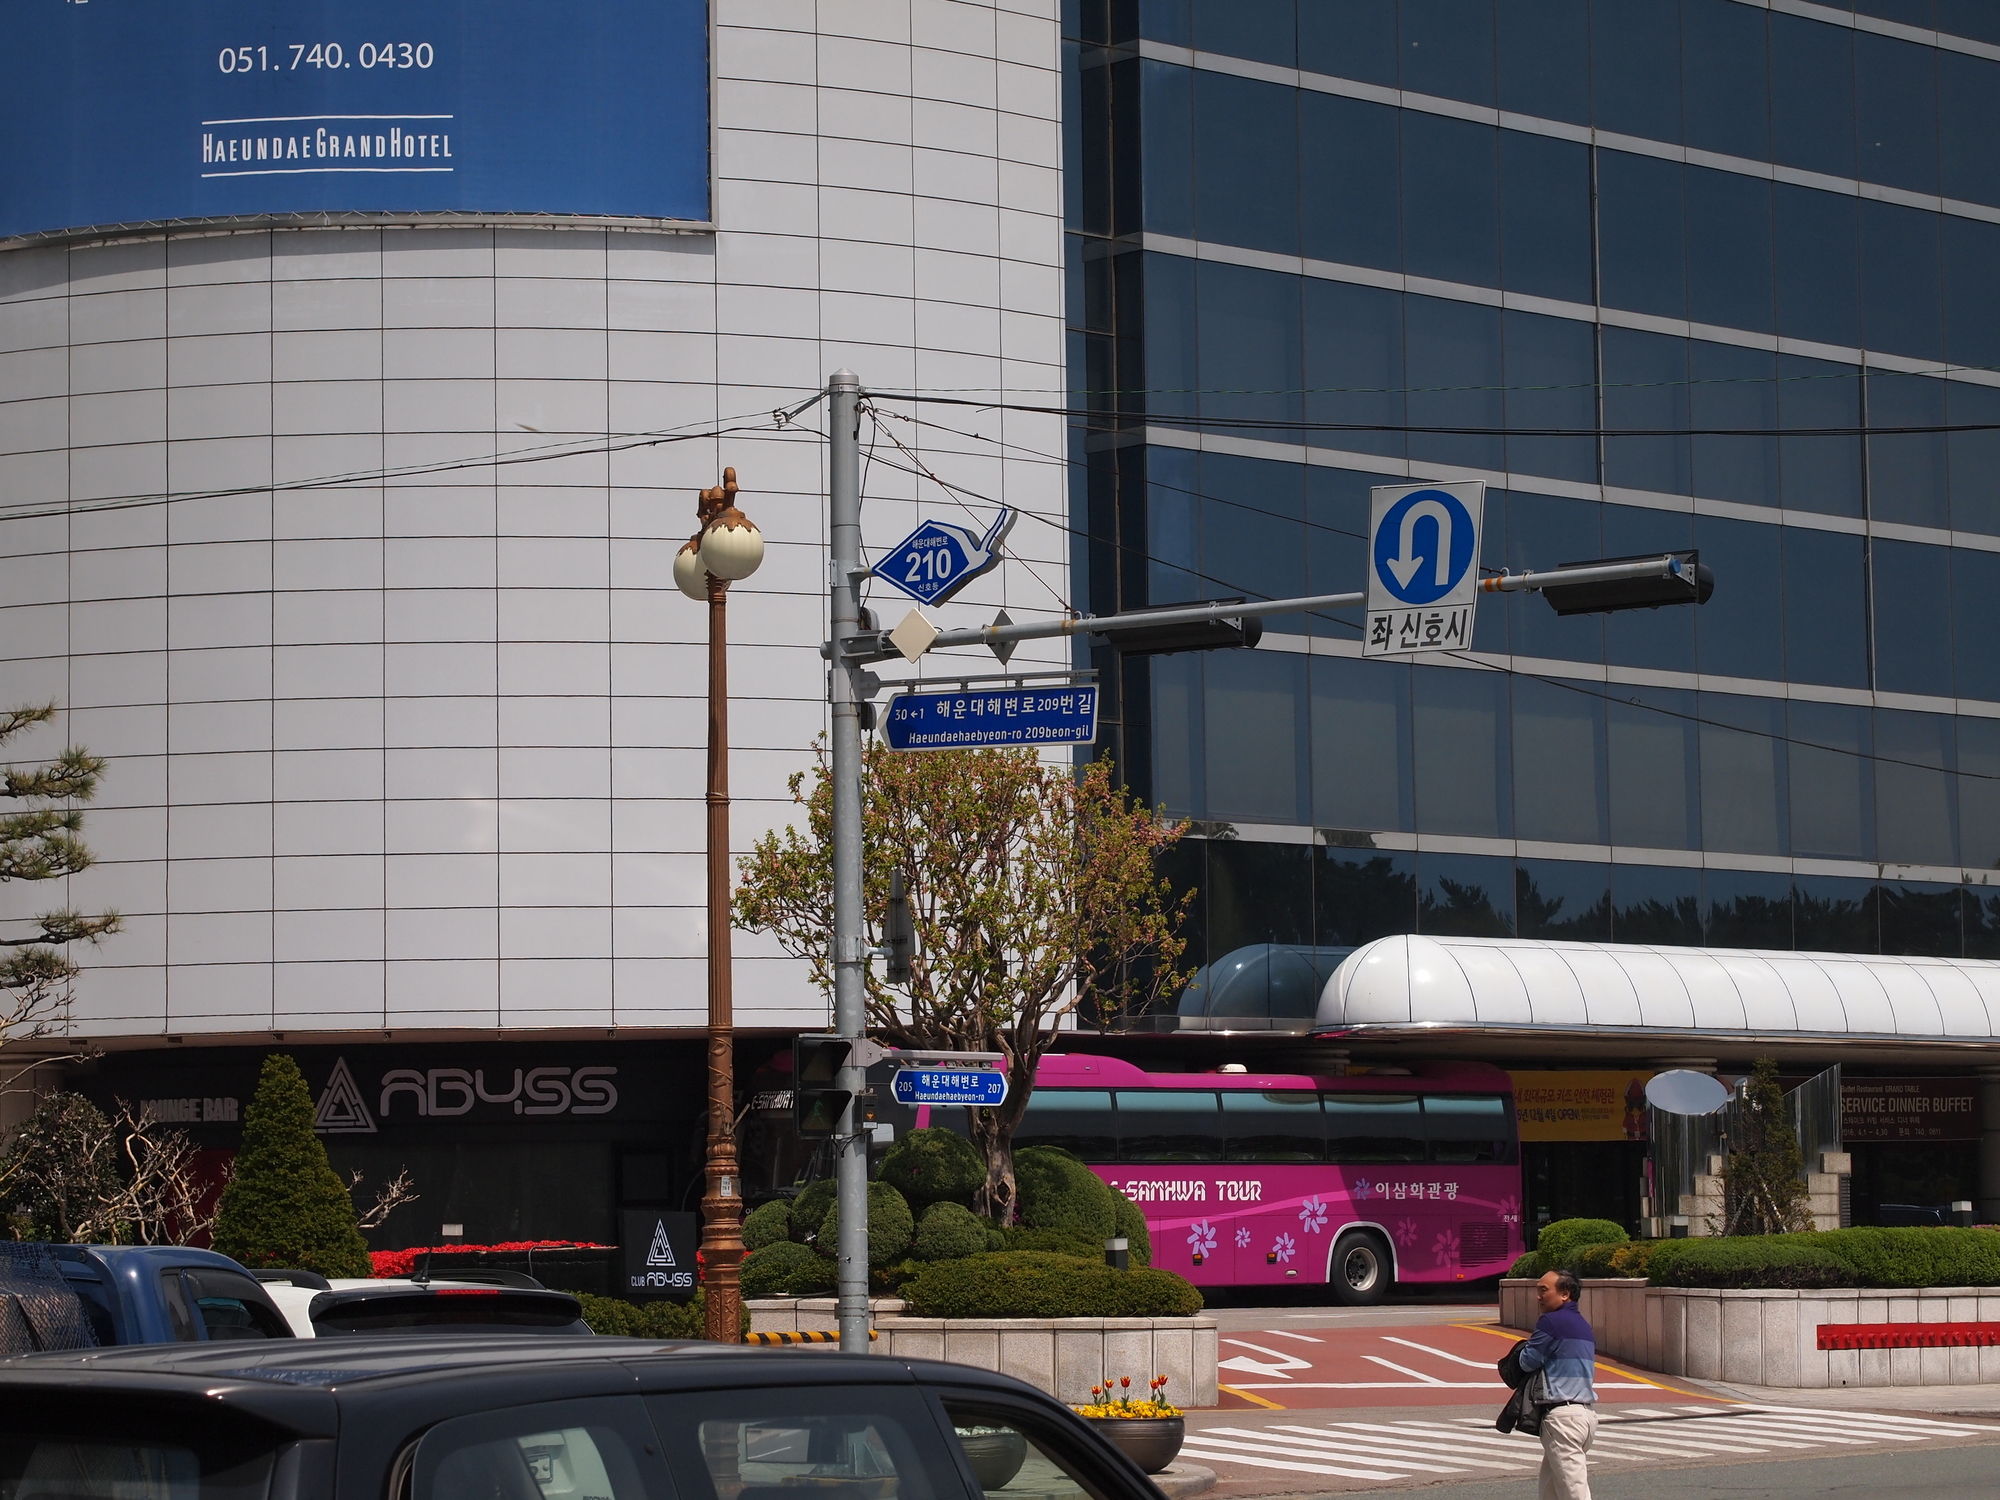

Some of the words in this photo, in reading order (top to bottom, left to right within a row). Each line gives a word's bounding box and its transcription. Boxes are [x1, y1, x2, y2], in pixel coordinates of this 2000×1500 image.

[218, 46, 281, 74] 051.
[288, 43, 351, 71] 740.
[359, 42, 434, 69] 0430
[911, 535, 949, 550] 해운대해변로
[904, 548, 952, 583] 210
[917, 581, 940, 593] 신호등
[1370, 614, 1394, 651] 좌
[1399, 608, 1469, 649] 신호시
[894, 708, 908, 721] 30
[908, 729, 1022, 745] Haeundaehaebyeon-ro
[1024, 724, 1090, 740] 209beon-gil
[898, 1081, 914, 1092] 205
[921, 1074, 979, 1090] 해운대해변로
[987, 1083, 1001, 1094] 207
[379, 1066, 619, 1117] ABYSS
[914, 1091, 985, 1102] Haeundaehaebyeon-ro
[202, 1097, 239, 1122] BAR
[1842, 1097, 1886, 1113] SERVICE
[1888, 1097, 1930, 1113] DINNER
[1933, 1097, 1974, 1112] BUFFET
[1215, 1180, 1262, 1201] TOUR
[1375, 1182, 1460, 1200] 이삼화관광
[630, 1275, 646, 1287] CLUB
[646, 1271, 693, 1288] ABYSS
